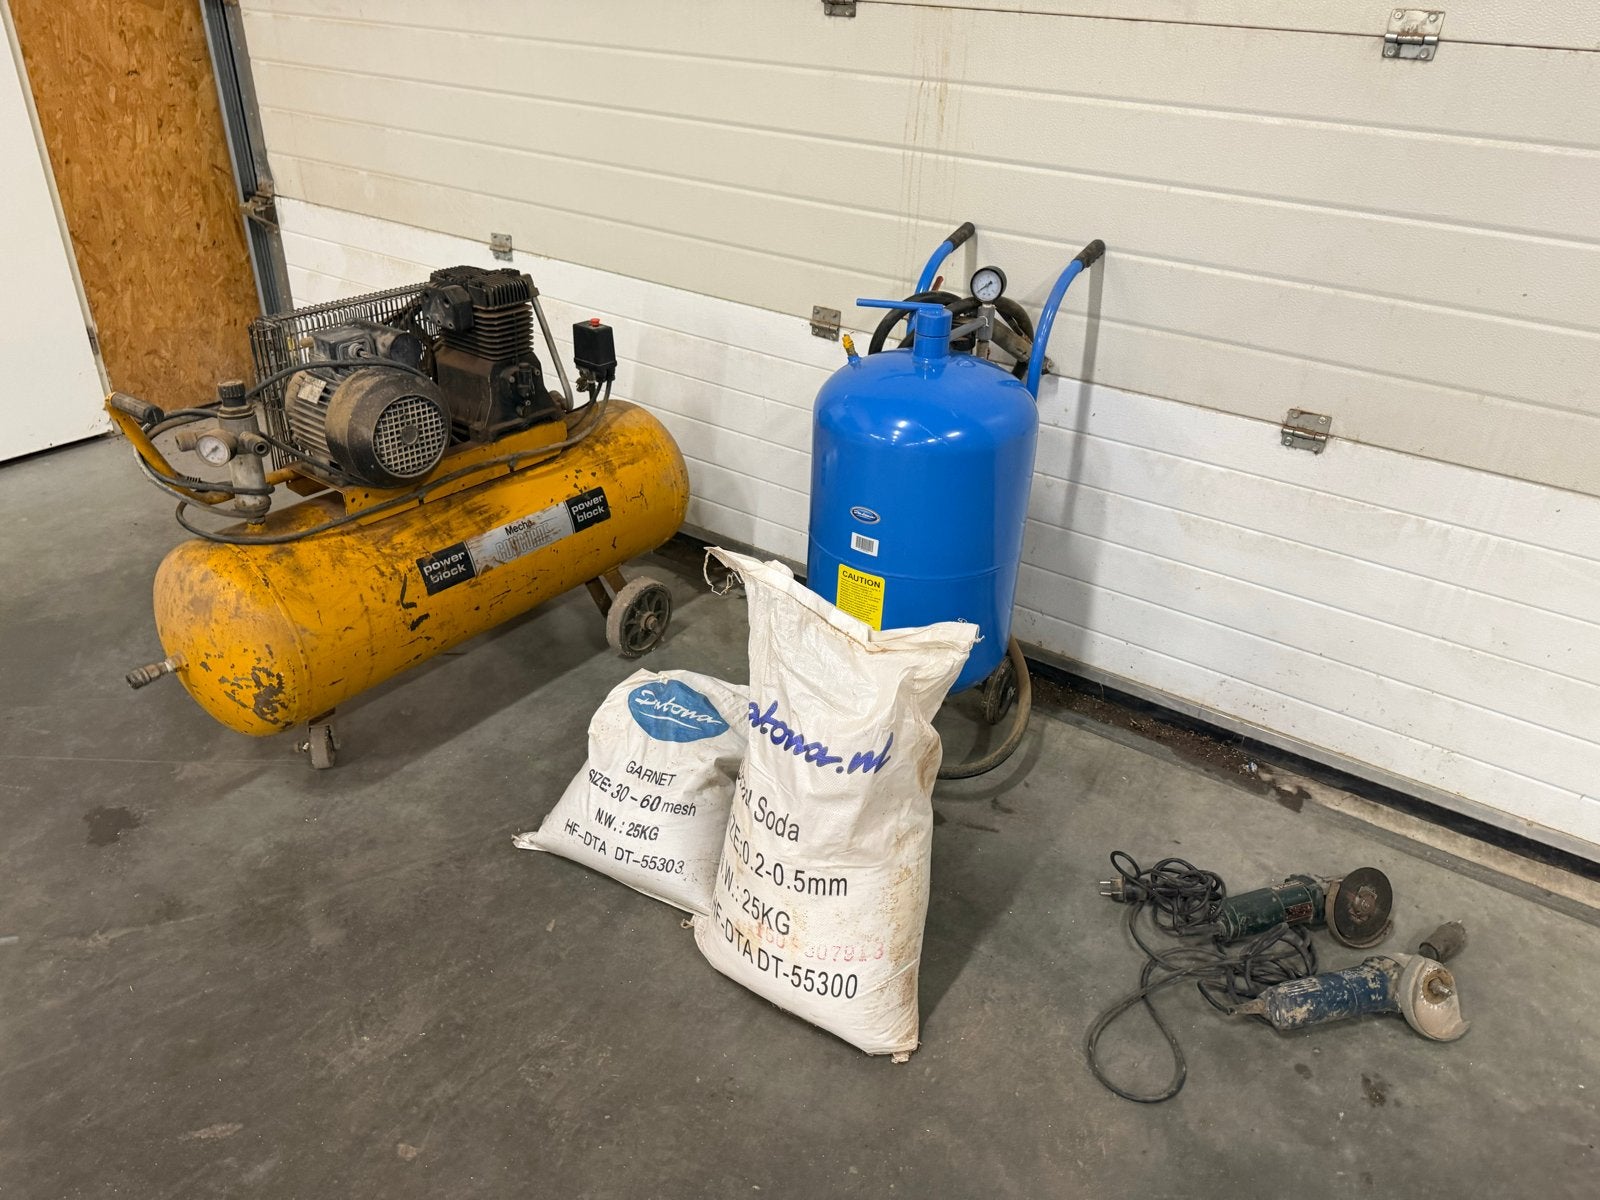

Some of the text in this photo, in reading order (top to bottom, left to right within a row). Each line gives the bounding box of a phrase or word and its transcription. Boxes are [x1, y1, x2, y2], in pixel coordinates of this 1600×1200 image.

[571, 495, 604, 515] power
[577, 505, 605, 523] block
[423, 551, 466, 576] power
[430, 563, 467, 584] block
[842, 570, 881, 589] CAUTION
[625, 760, 676, 787] GARNET
[661, 801, 697, 817] mesh
[754, 796, 800, 843] Soda
[625, 822, 660, 842] 25KG
[564, 818, 685, 875] HF-DTA DT-55303
[757, 947, 858, 1000] DT-55300
